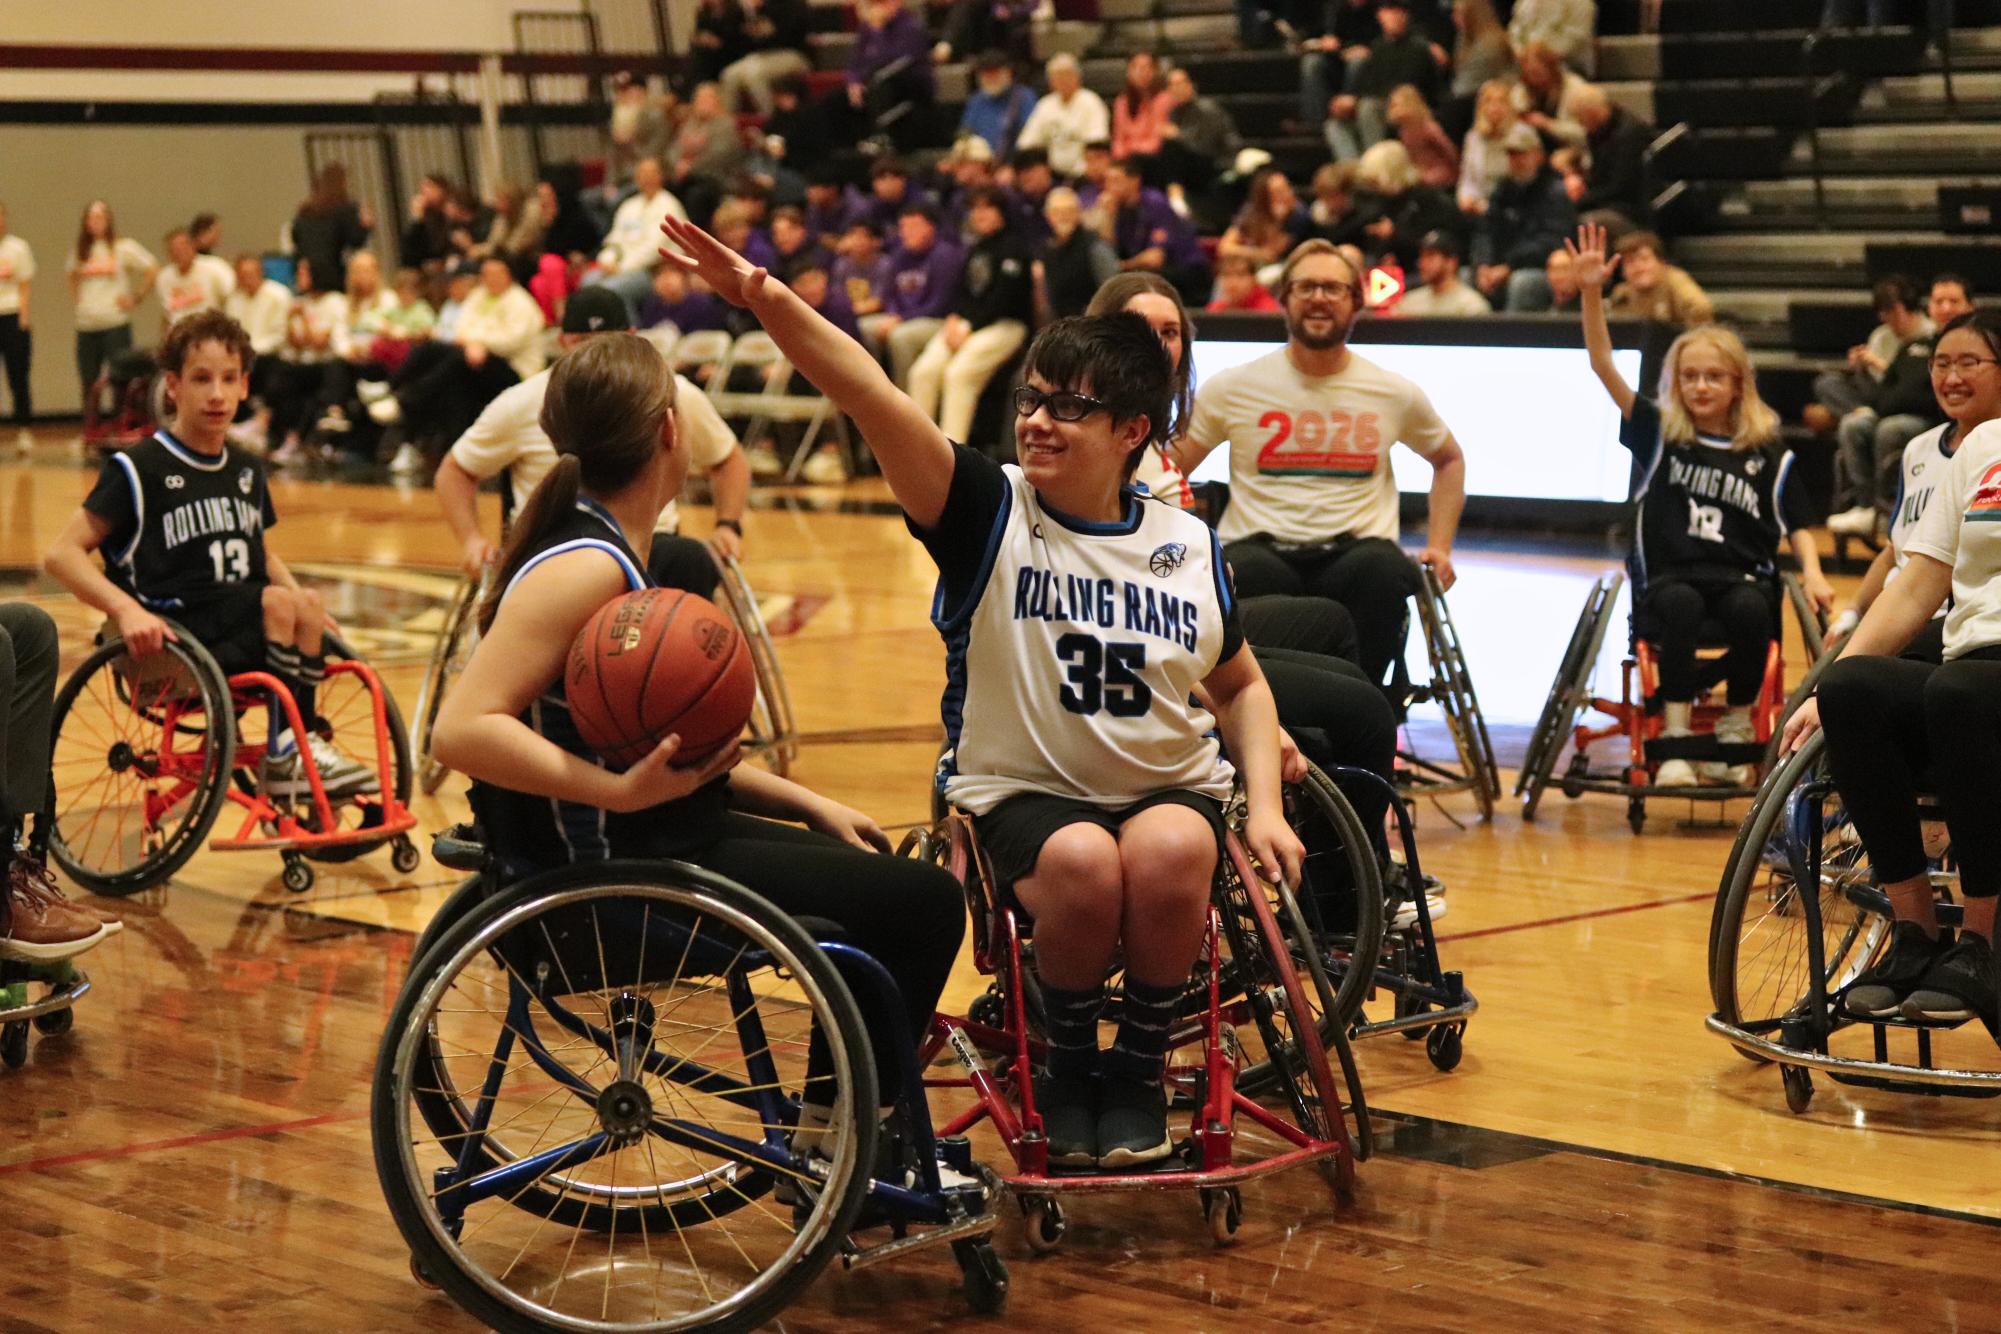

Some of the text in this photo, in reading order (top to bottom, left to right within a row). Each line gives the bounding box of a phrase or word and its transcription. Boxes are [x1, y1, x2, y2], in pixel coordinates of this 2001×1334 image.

[1257, 410, 1380, 460] 2026
[163, 496, 235, 550] ROLLING
[209, 538, 250, 582] 13
[1124, 581, 1197, 654] RAMS
[1056, 632, 1152, 717] 35
